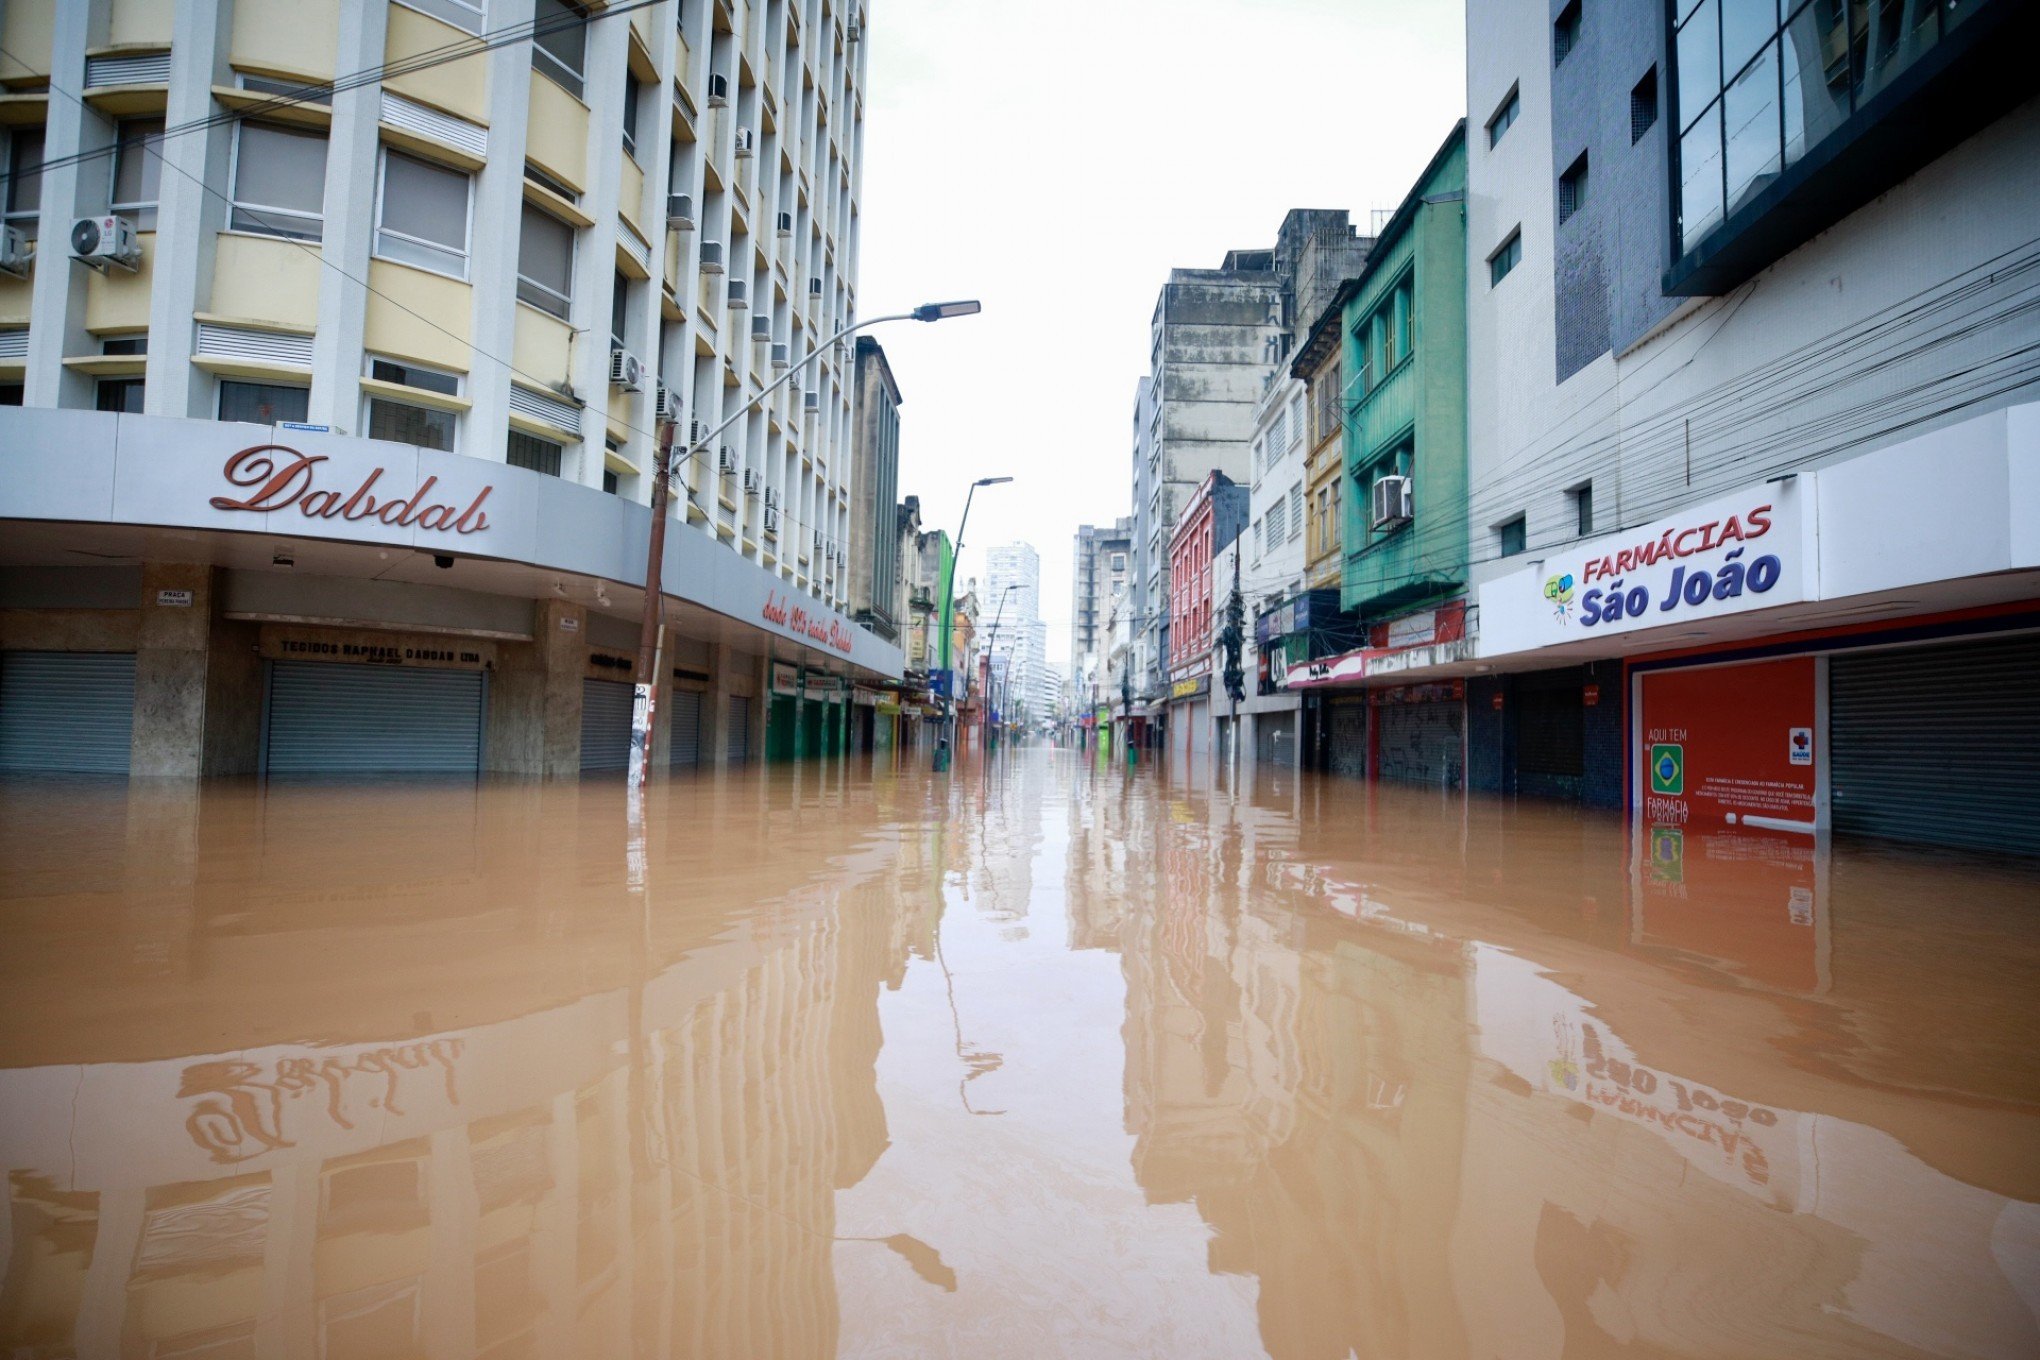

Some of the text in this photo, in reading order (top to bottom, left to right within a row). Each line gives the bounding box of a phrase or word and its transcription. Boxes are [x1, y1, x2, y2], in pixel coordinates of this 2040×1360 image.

[209, 445, 493, 534] Dabdab
[1583, 504, 1772, 584] FARMÁCIAS
[1579, 546, 1782, 627] São João
[1648, 728, 1687, 742] AQUI TEM
